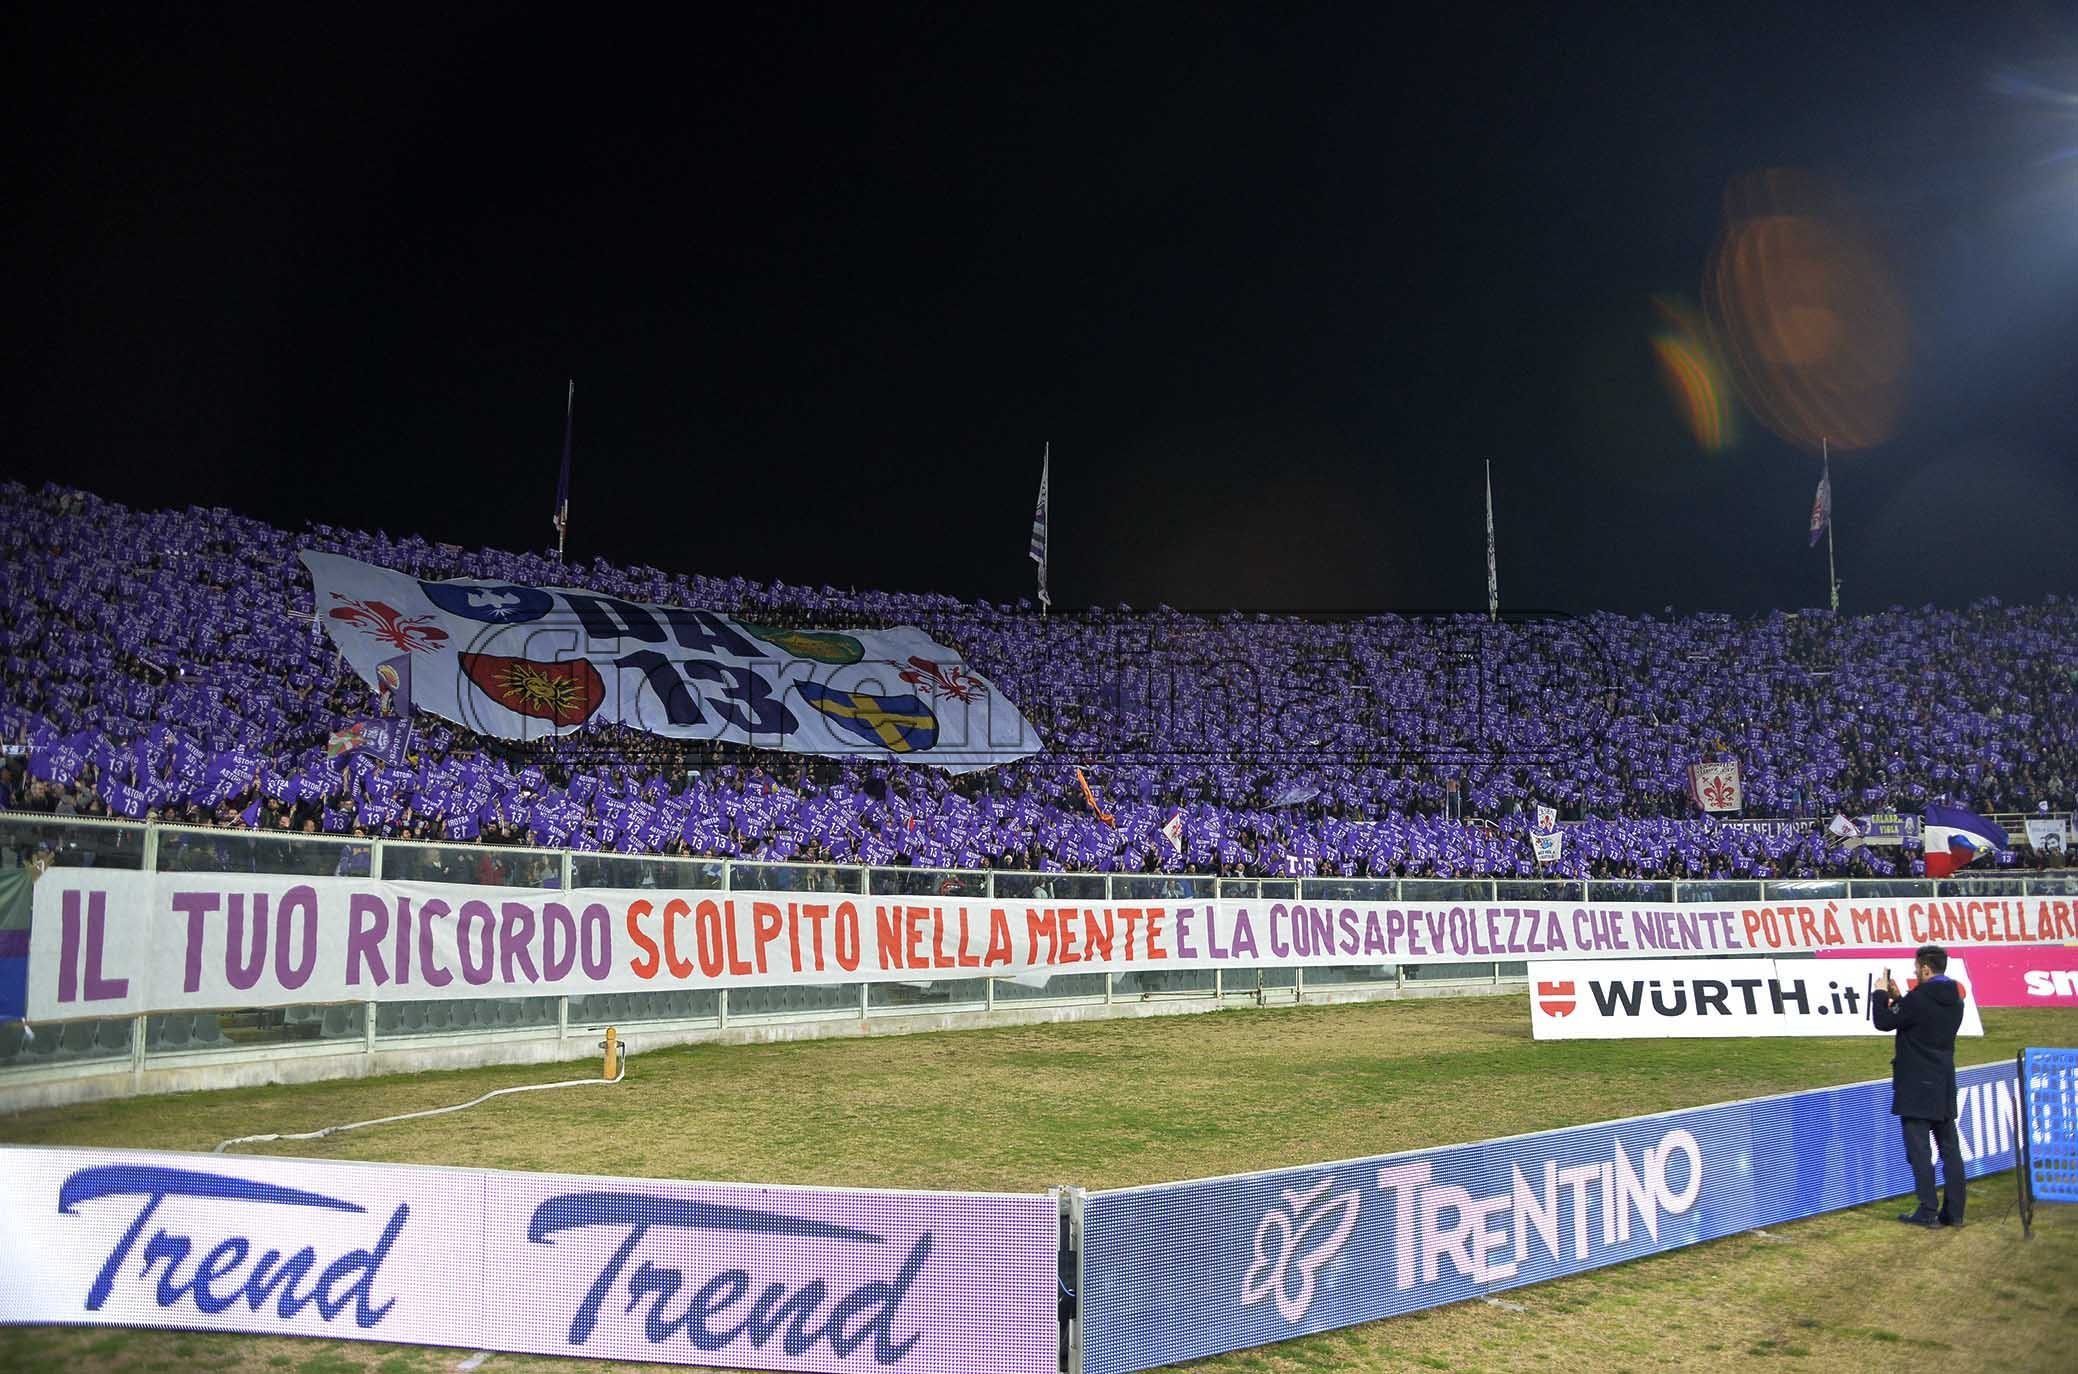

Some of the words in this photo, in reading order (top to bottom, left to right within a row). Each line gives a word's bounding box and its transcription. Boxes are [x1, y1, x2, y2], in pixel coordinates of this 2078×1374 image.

[613, 649, 799, 736] 13
[109, 759, 123, 772] 13
[51, 768, 68, 782] 13
[220, 768, 242, 784] ASTORI
[216, 779, 232, 794] 13
[301, 779, 321, 792] ASTORI
[317, 780, 330, 792] 13
[525, 777, 535, 786] 13
[122, 785, 145, 800] ASTORI
[376, 784, 388, 795] 13
[629, 785, 638, 795] 13
[124, 799, 138, 815] 13
[422, 804, 433, 816] 13
[466, 800, 477, 813] 13
[606, 801, 626, 809] ASTORI
[607, 808, 619, 819] 13
[769, 807, 778, 816] 13
[995, 809, 1004, 817] 13
[368, 813, 380, 824] 13
[512, 812, 522, 823] 13
[1239, 818, 1248, 827] 13
[333, 818, 344, 830] 13
[567, 821, 578, 831] 13
[627, 822, 640, 834] 13
[831, 823, 840, 834] 13
[603, 829, 614, 842] 13
[748, 826, 758, 836] 13
[794, 831, 804, 842] 13
[810, 826, 821, 836] 13
[648, 835, 660, 846] 13
[692, 837, 702, 849] 13
[715, 837, 726, 848] 13
[942, 857, 950, 867] 13
[1476, 864, 1484, 872] 13
[58, 890, 129, 1002] IL
[173, 885, 318, 993] TUO
[346, 893, 612, 985] RICORDO
[627, 899, 860, 979] SCOLPITO
[876, 905, 1013, 970] NELLA
[1027, 907, 1168, 965] MENTE
[1177, 908, 1197, 958] E
[1207, 906, 1259, 959] LA
[1270, 903, 1567, 958] CONSAPEVOLEZZA
[1572, 909, 1629, 950] CHE
[1632, 910, 1737, 949] NIENTE
[1742, 901, 1845, 947] POTRÀ
[1851, 908, 1901, 944] MAI
[1376, 1127, 1703, 1290] TRENTINO
[57, 1164, 411, 1328] Trend
[527, 1191, 934, 1366] Trend
